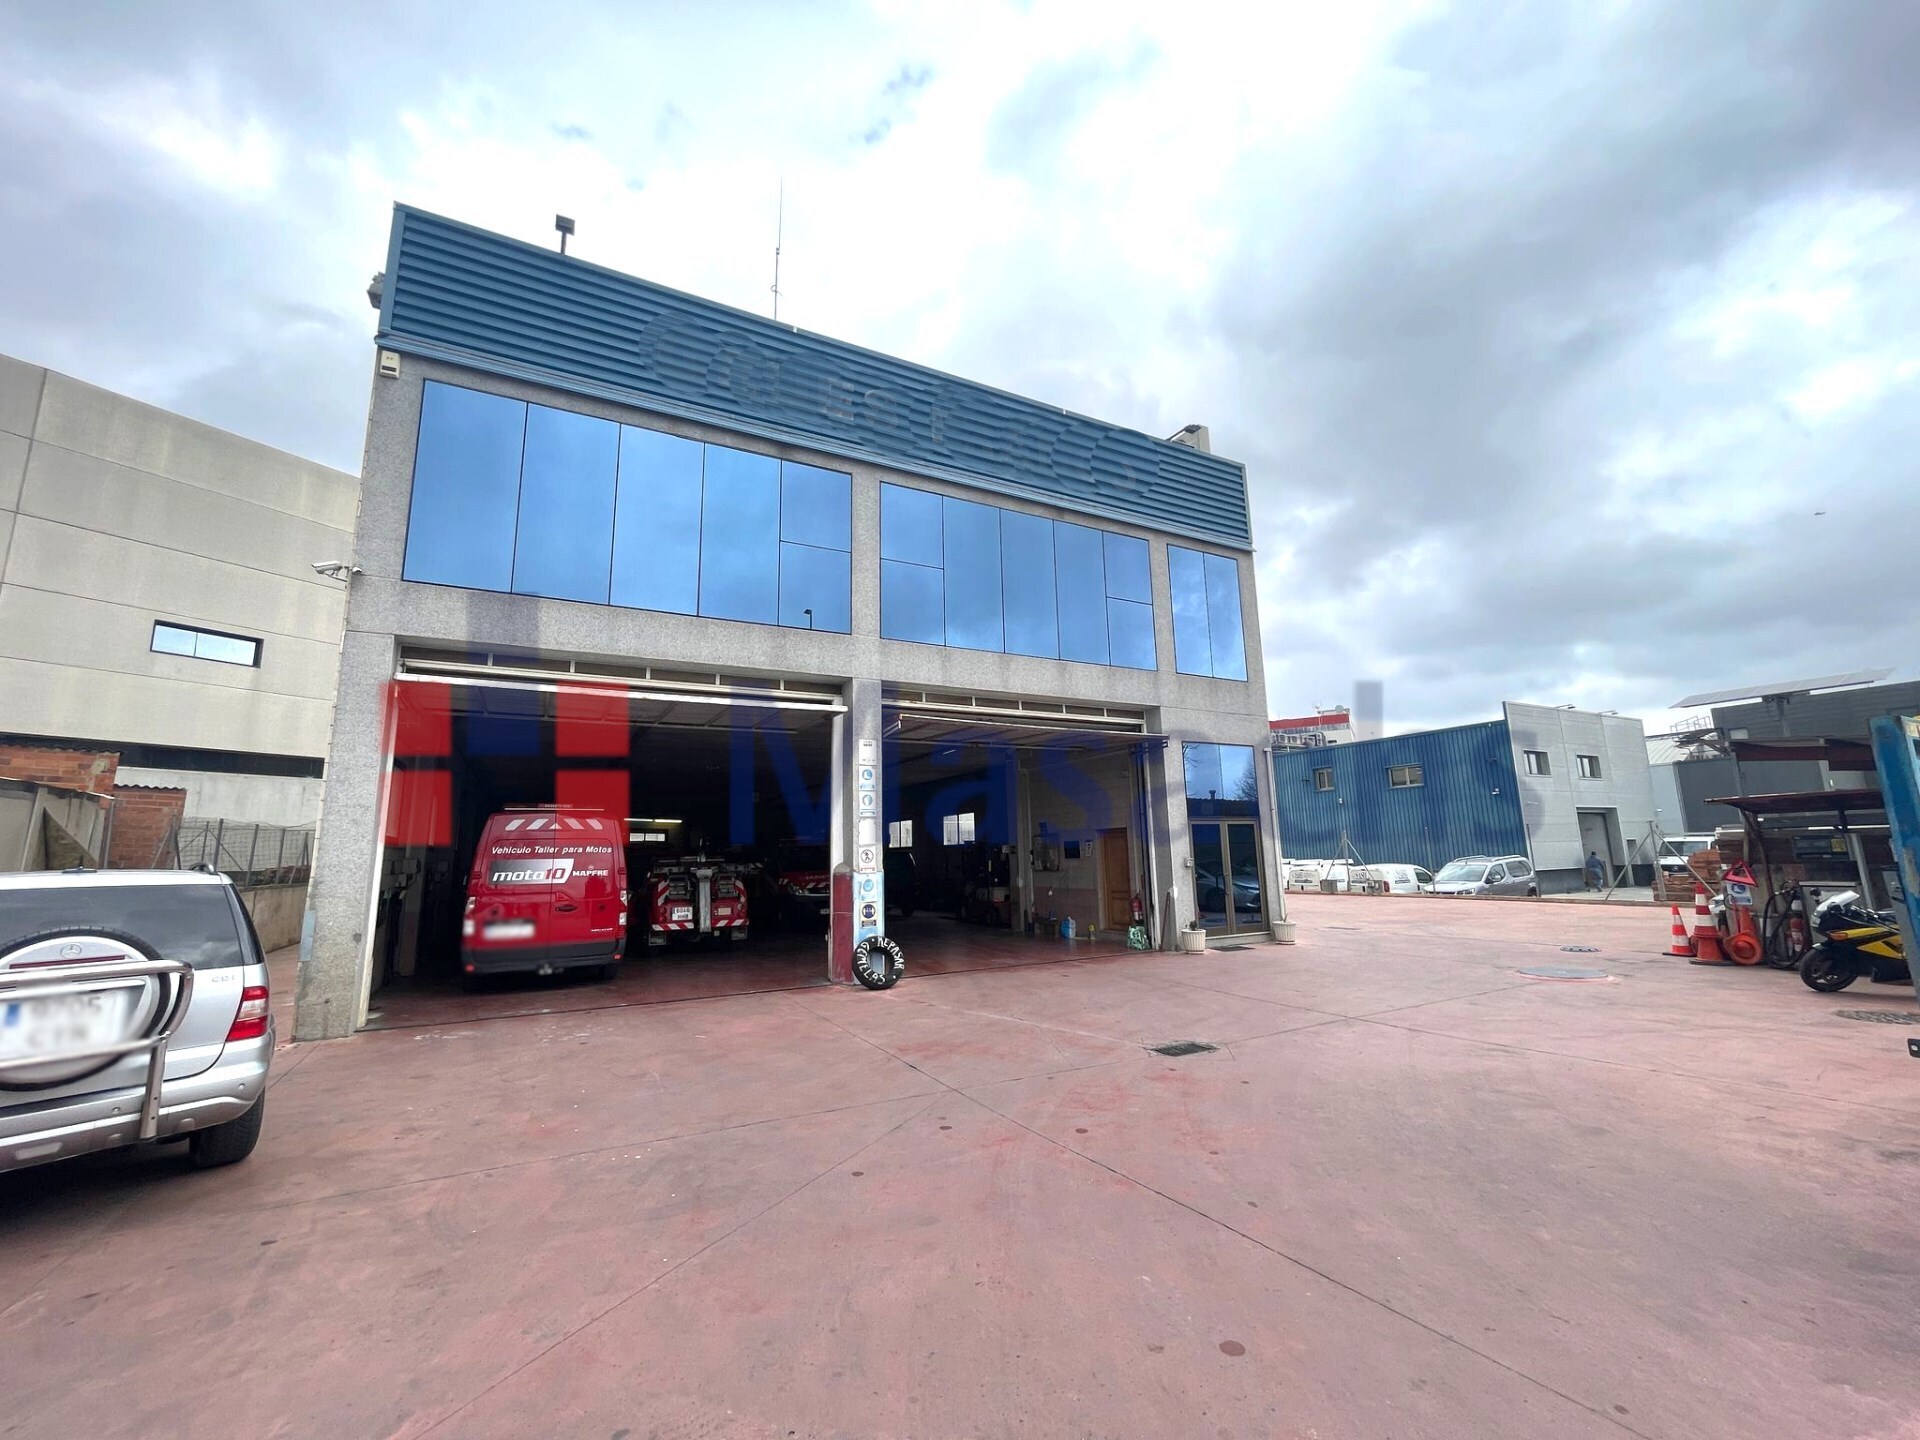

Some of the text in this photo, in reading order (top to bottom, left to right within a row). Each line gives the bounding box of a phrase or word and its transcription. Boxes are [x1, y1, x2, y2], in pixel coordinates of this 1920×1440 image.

[534, 845, 558, 854] Taller
[562, 846, 583, 855] para
[585, 845, 612, 854] Motos
[572, 869, 609, 877] MAPFRE
[877, 936, 905, 970] REPASAR
